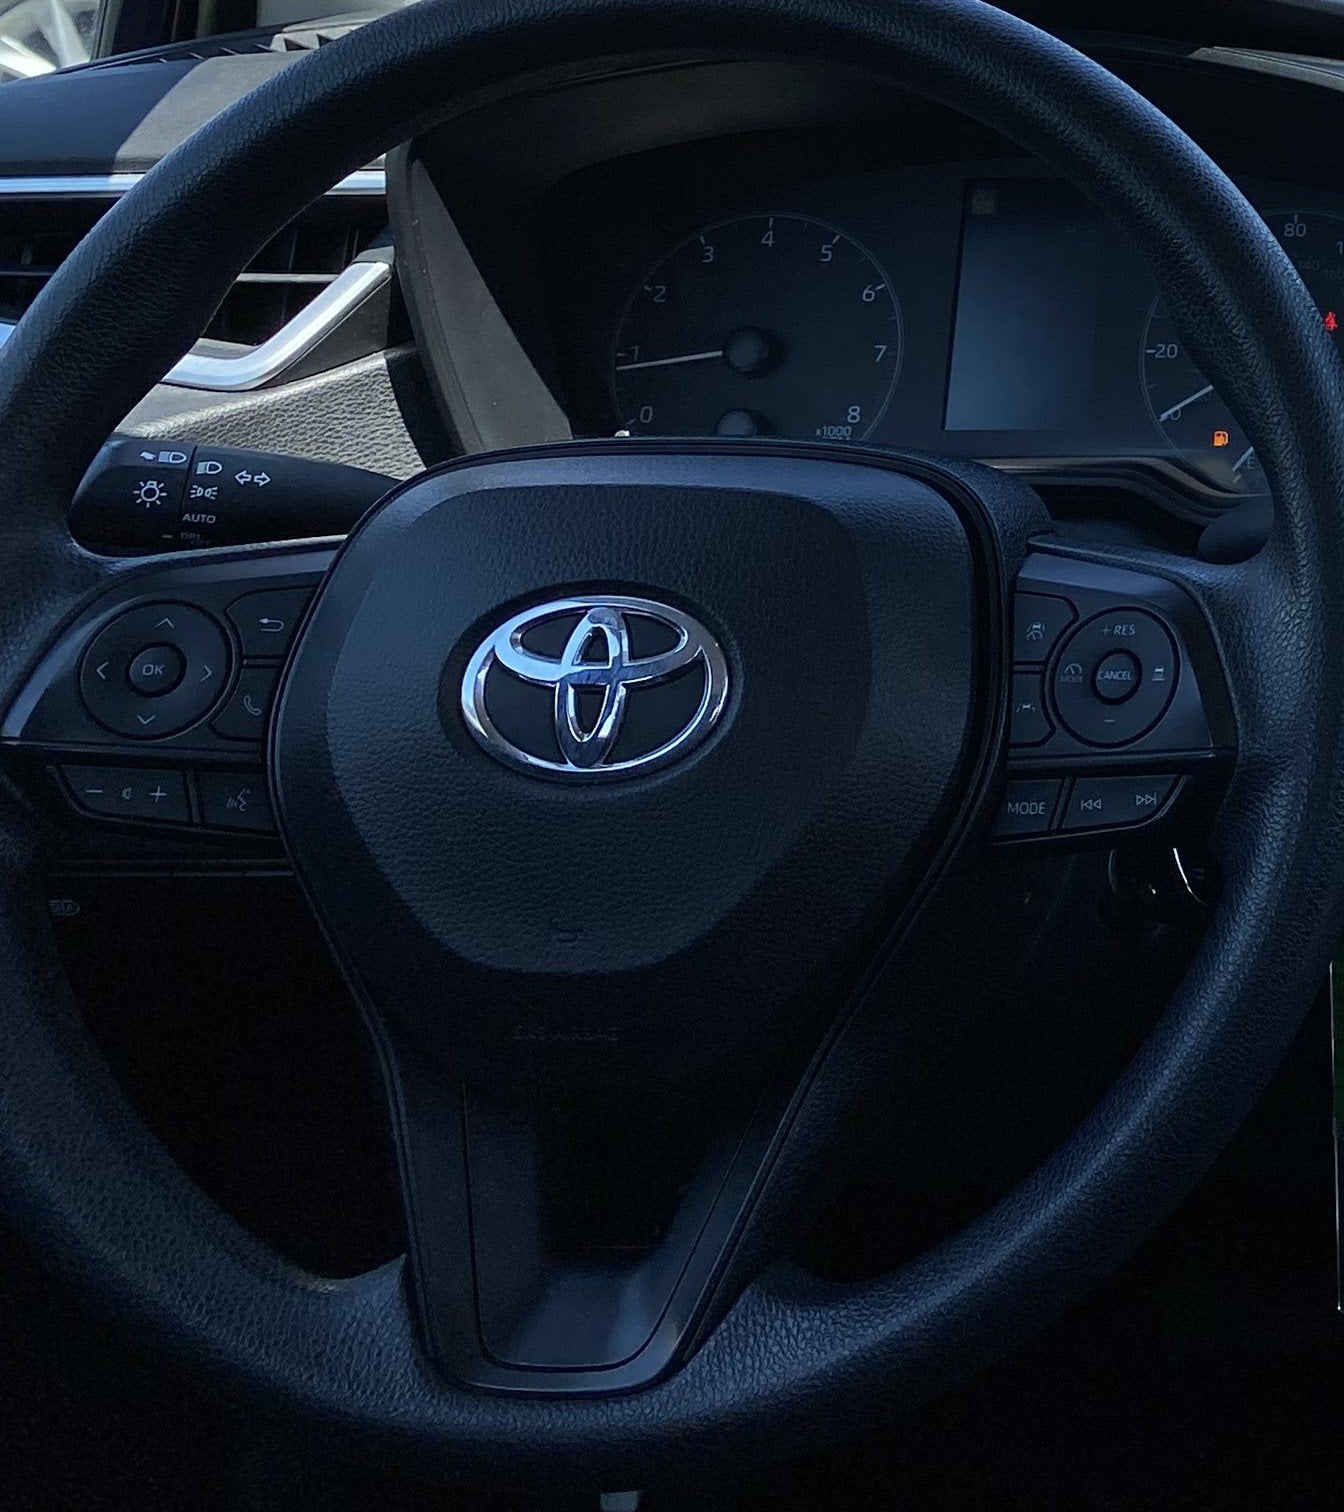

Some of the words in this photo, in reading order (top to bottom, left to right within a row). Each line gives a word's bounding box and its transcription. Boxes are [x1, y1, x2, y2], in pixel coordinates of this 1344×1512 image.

[1283, 223, 1307, 238] 80
[760, 232, 775, 247] 4
[702, 247, 715, 263] 3
[819, 245, 833, 262] 5
[652, 285, 667, 303] 2
[862, 284, 876, 303] 6
[631, 345, 640, 361] 1
[874, 345, 887, 362] 7
[1154, 344, 1178, 359] 20
[639, 406, 653, 424] 0
[846, 406, 861, 424] 8
[815, 425, 852, 437] x1000
[182, 513, 217, 524] AUTO
[1113, 624, 1136, 636] RES
[142, 663, 165, 676] OK
[1098, 670, 1132, 681] CANCEL
[1007, 801, 1046, 815] MODE
